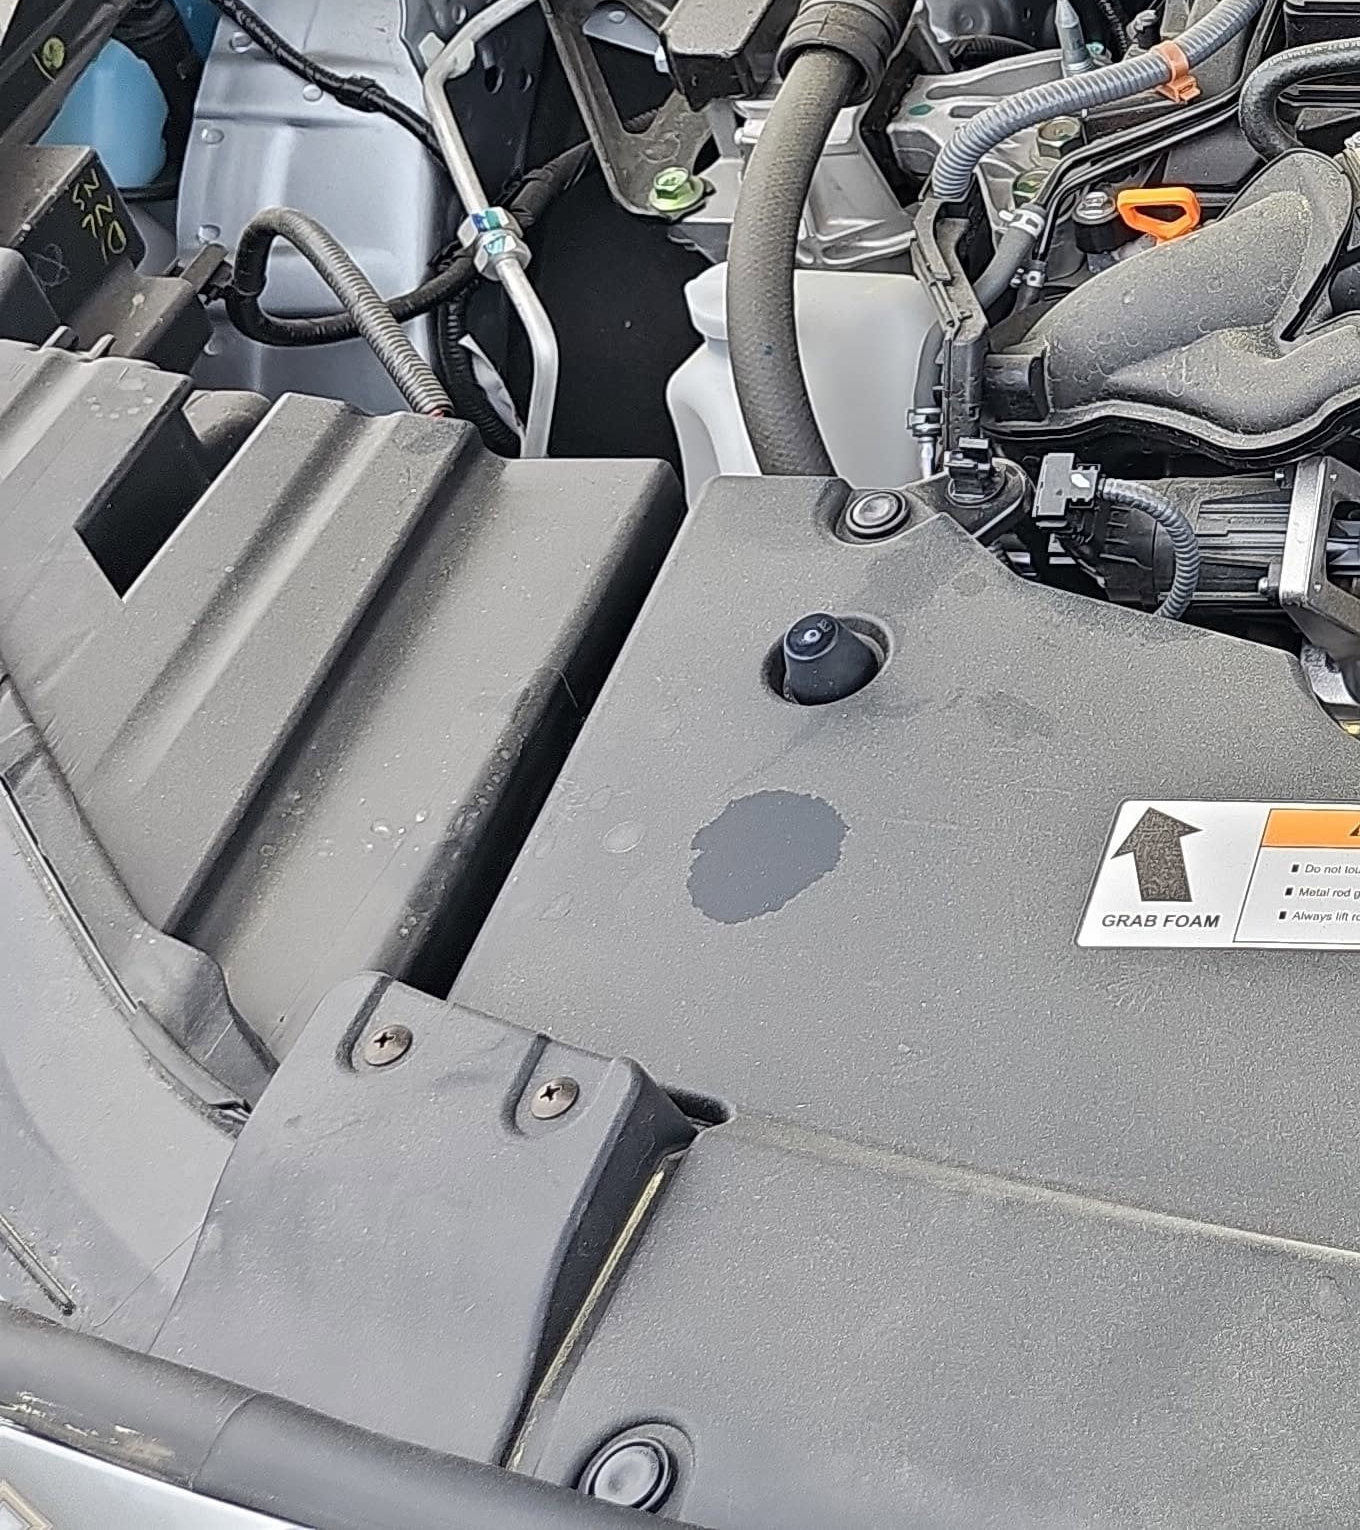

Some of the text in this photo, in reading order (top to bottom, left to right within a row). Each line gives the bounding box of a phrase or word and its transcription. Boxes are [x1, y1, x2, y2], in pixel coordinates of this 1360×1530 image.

[1305, 864, 1321, 873] Do
[1324, 865, 1341, 873] not
[1299, 888, 1330, 897] Metal
[1332, 888, 1351, 897] rod
[1101, 914, 1221, 929] GRAB FOAM
[1292, 911, 1332, 923] Always
[1335, 912, 1349, 921] lift
